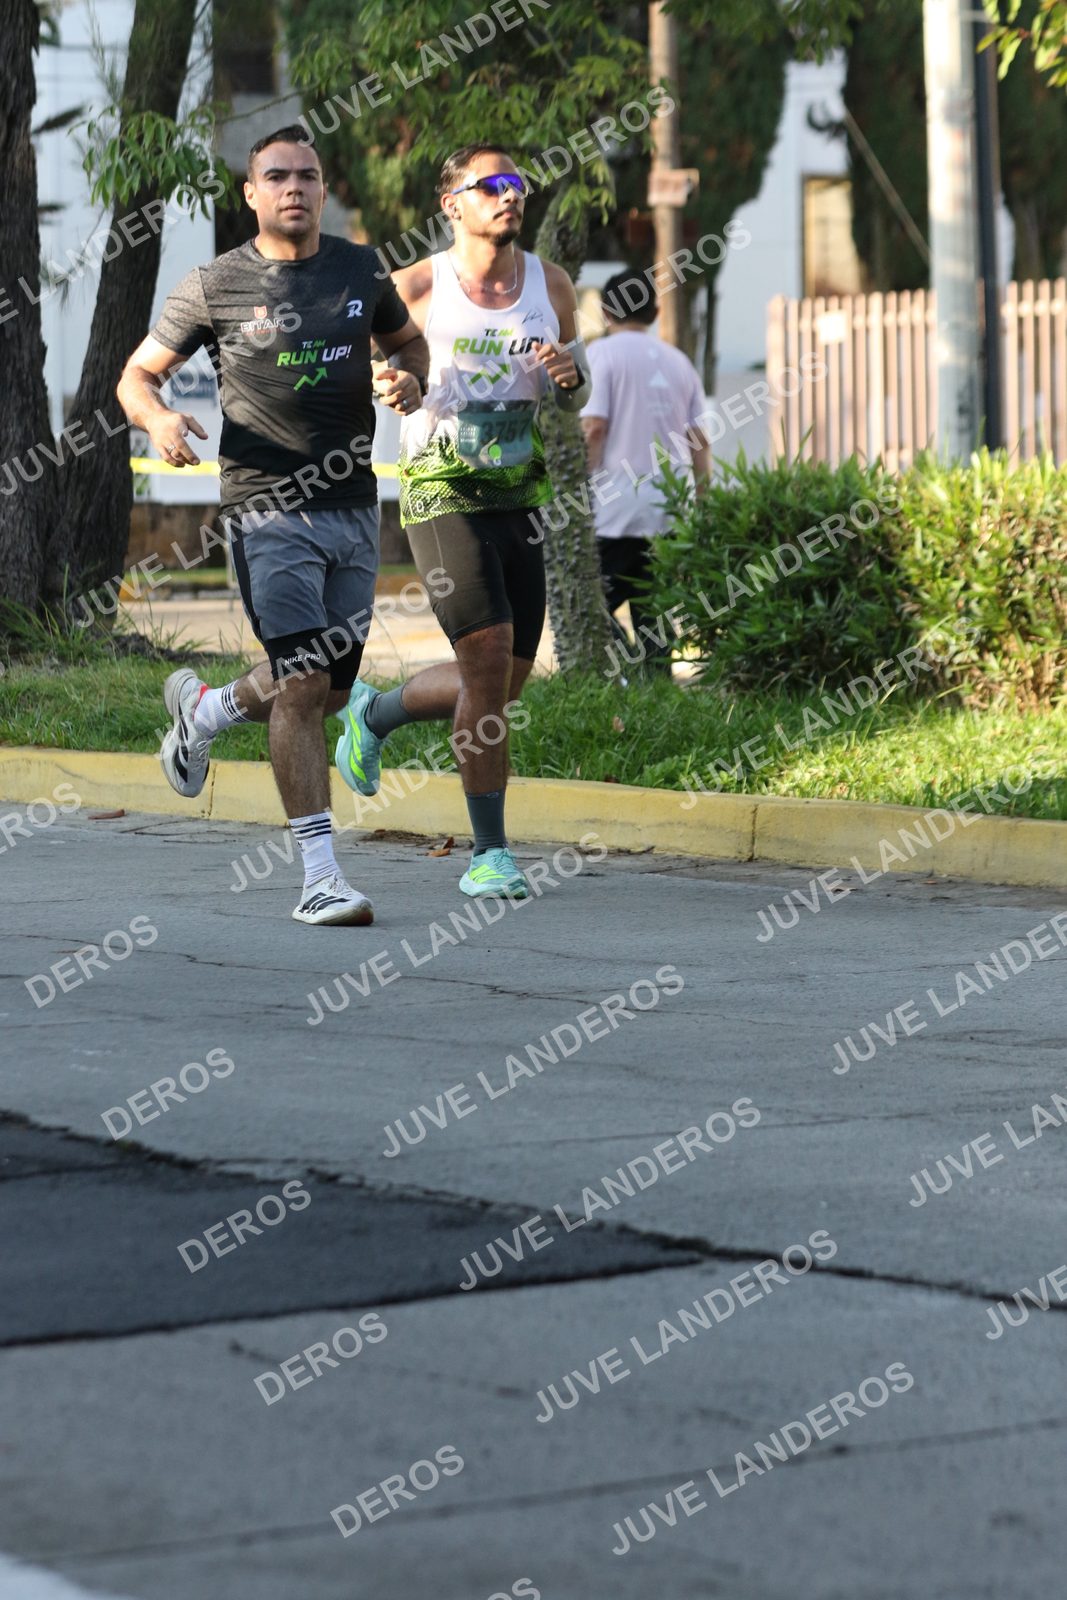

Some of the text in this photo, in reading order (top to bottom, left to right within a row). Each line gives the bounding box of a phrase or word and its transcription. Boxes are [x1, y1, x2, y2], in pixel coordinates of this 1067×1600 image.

[484, 328, 514, 337] TEAM
[302, 340, 326, 350] TEAM
[452, 338, 503, 356] RUN
[277, 345, 352, 367] RUN UP!
[284, 653, 321, 666] NIKE PRO
